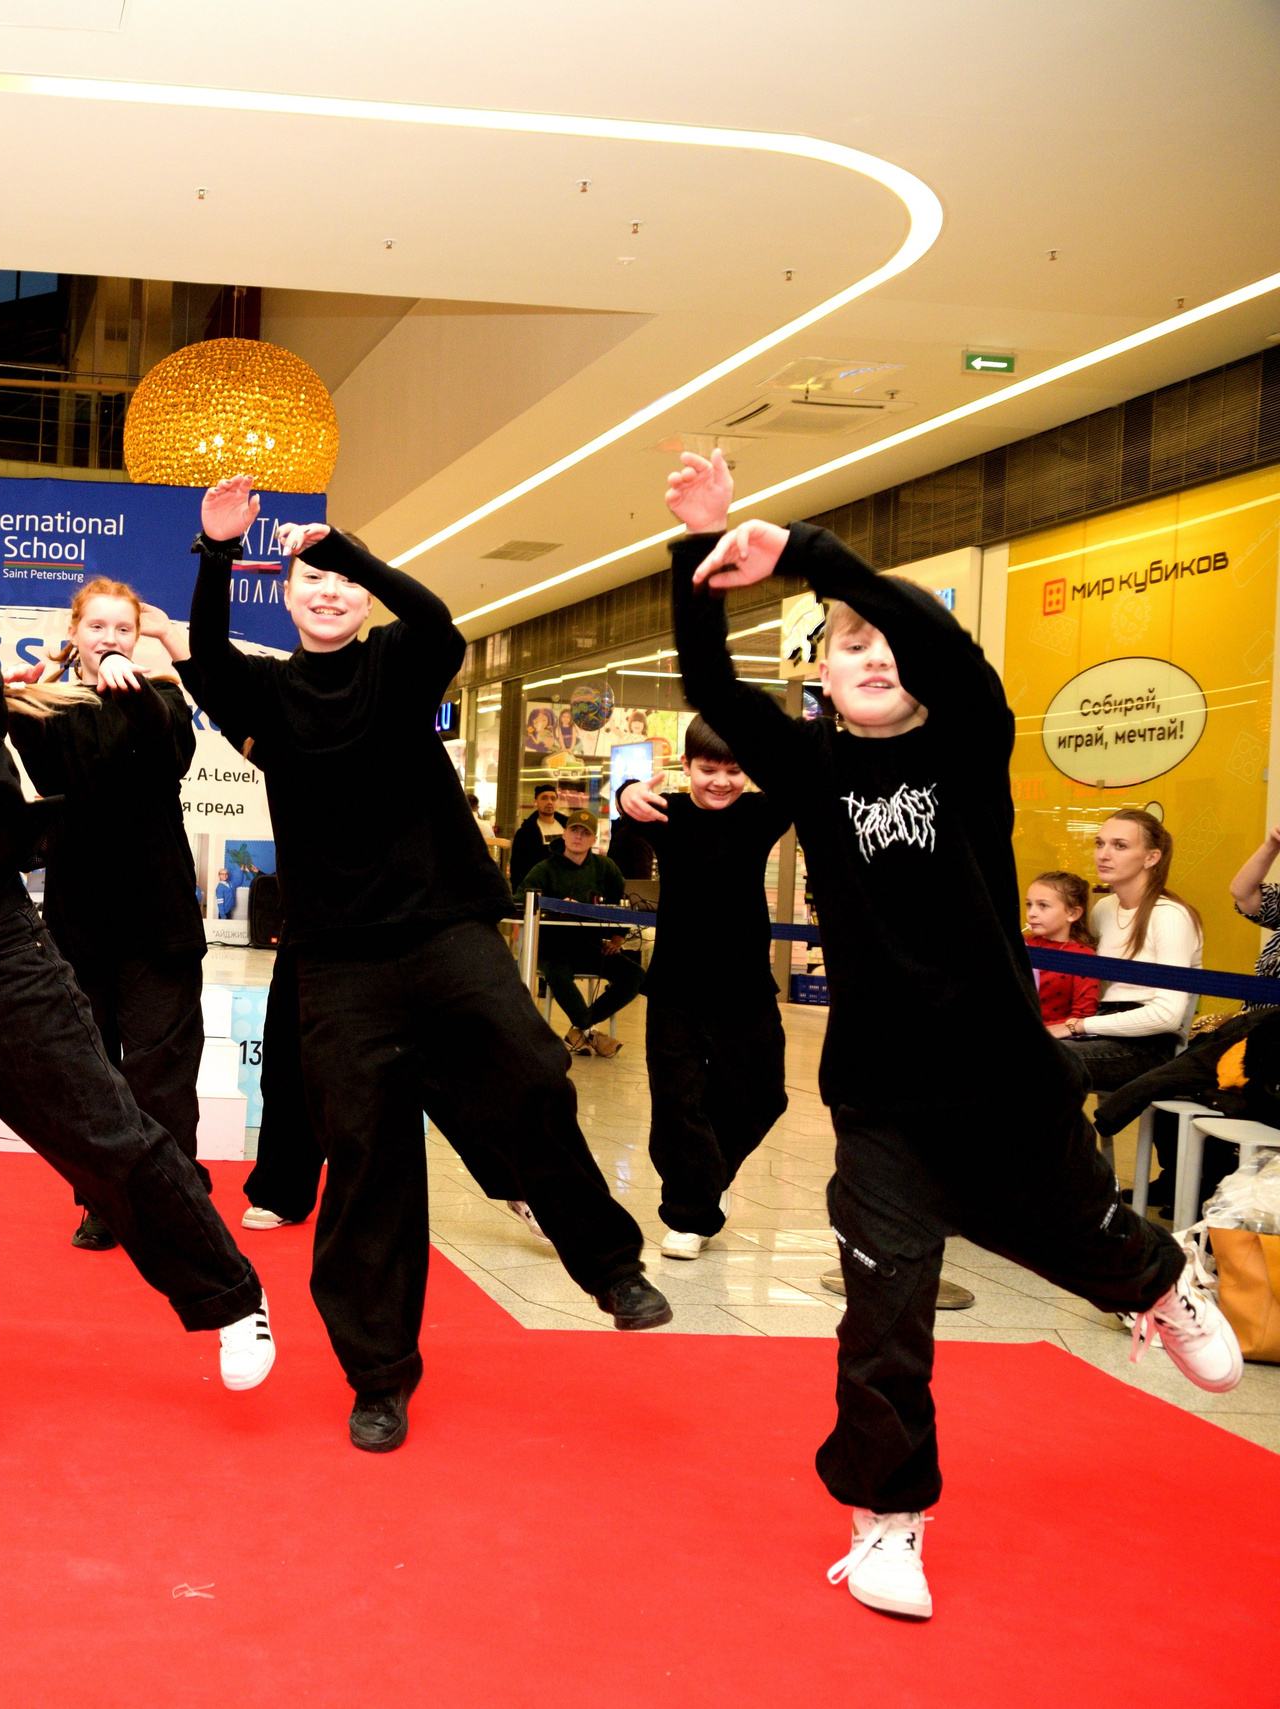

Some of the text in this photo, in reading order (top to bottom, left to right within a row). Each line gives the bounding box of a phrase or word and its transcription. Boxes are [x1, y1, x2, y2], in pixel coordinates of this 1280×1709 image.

[3, 536, 86, 561] School
[3, 568, 84, 583] Saint Petersburg
[1072, 551, 1230, 601] мир кубиков
[1080, 687, 1161, 717] Собирай,
[1057, 718, 1185, 753] играй, мечтай!
[197, 767, 259, 785] A-Level,
[196, 802, 244, 816] среда
[239, 1040, 262, 1066] 13
